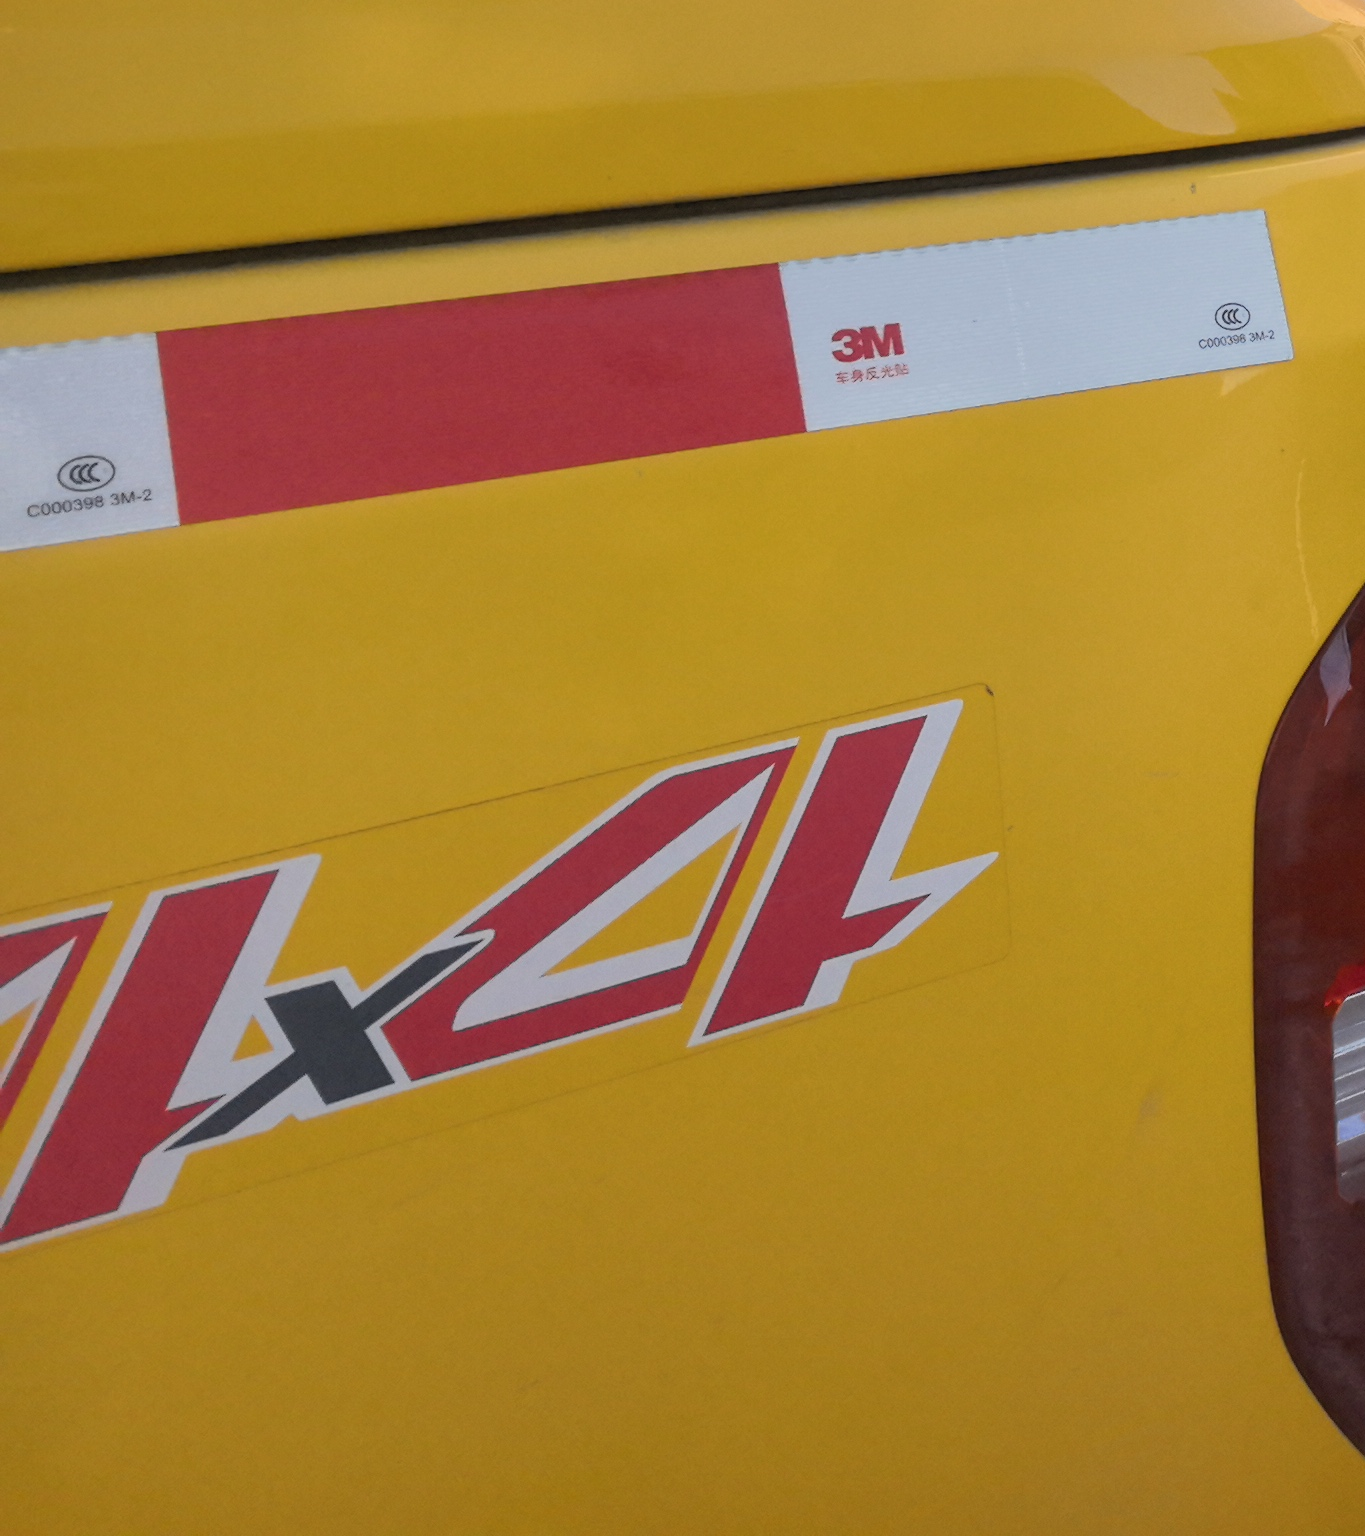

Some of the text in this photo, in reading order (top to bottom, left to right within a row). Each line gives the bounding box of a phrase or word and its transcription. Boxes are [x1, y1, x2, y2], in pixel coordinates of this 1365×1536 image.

[832, 323, 905, 363] 3M
[1198, 329, 1275, 350] C000398 3M-2
[835, 363, 910, 385] 车身反光贴
[26, 488, 153, 518] C000398 3M-2
